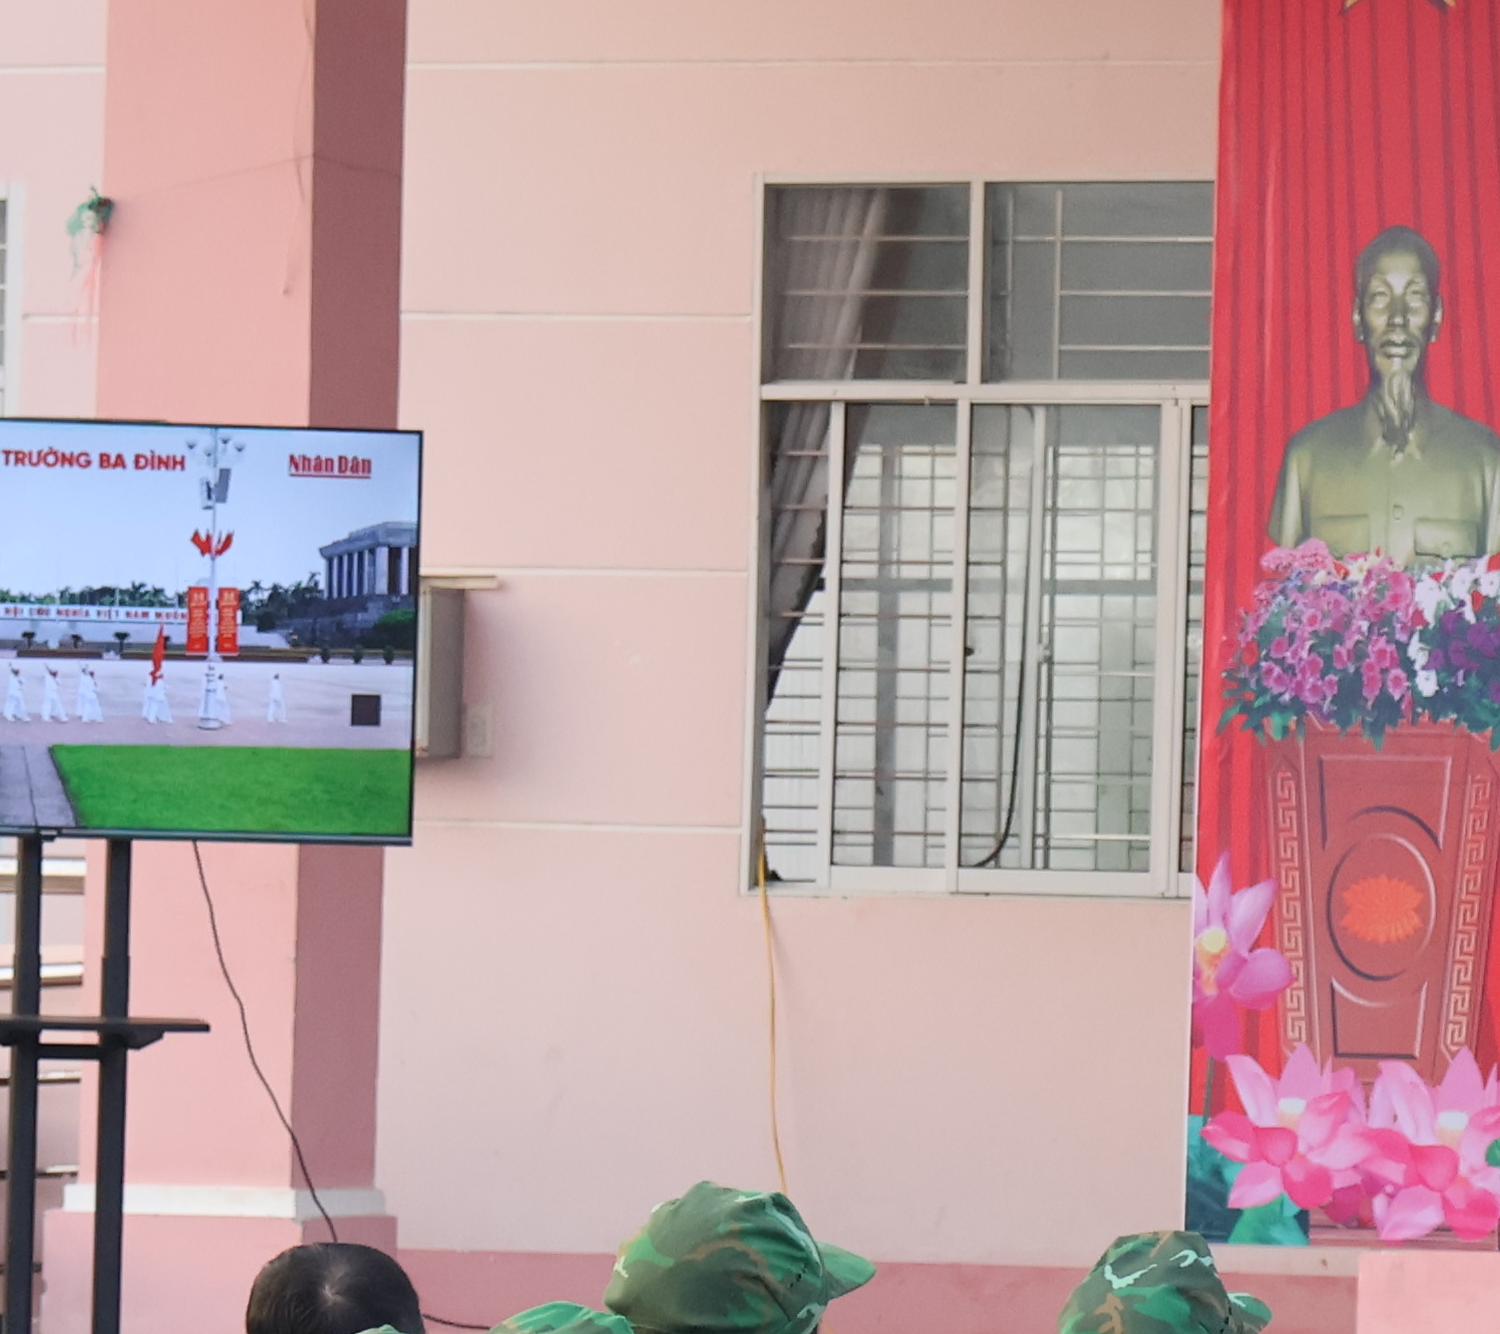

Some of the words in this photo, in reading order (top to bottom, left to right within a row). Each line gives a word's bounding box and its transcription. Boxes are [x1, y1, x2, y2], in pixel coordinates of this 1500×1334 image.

[2, 448, 92, 469] TRƯỜNG
[100, 453, 127, 469] BA
[134, 450, 186, 471] ĐÌNH
[288, 454, 335, 474] Nhân
[338, 455, 372, 475] Dân
